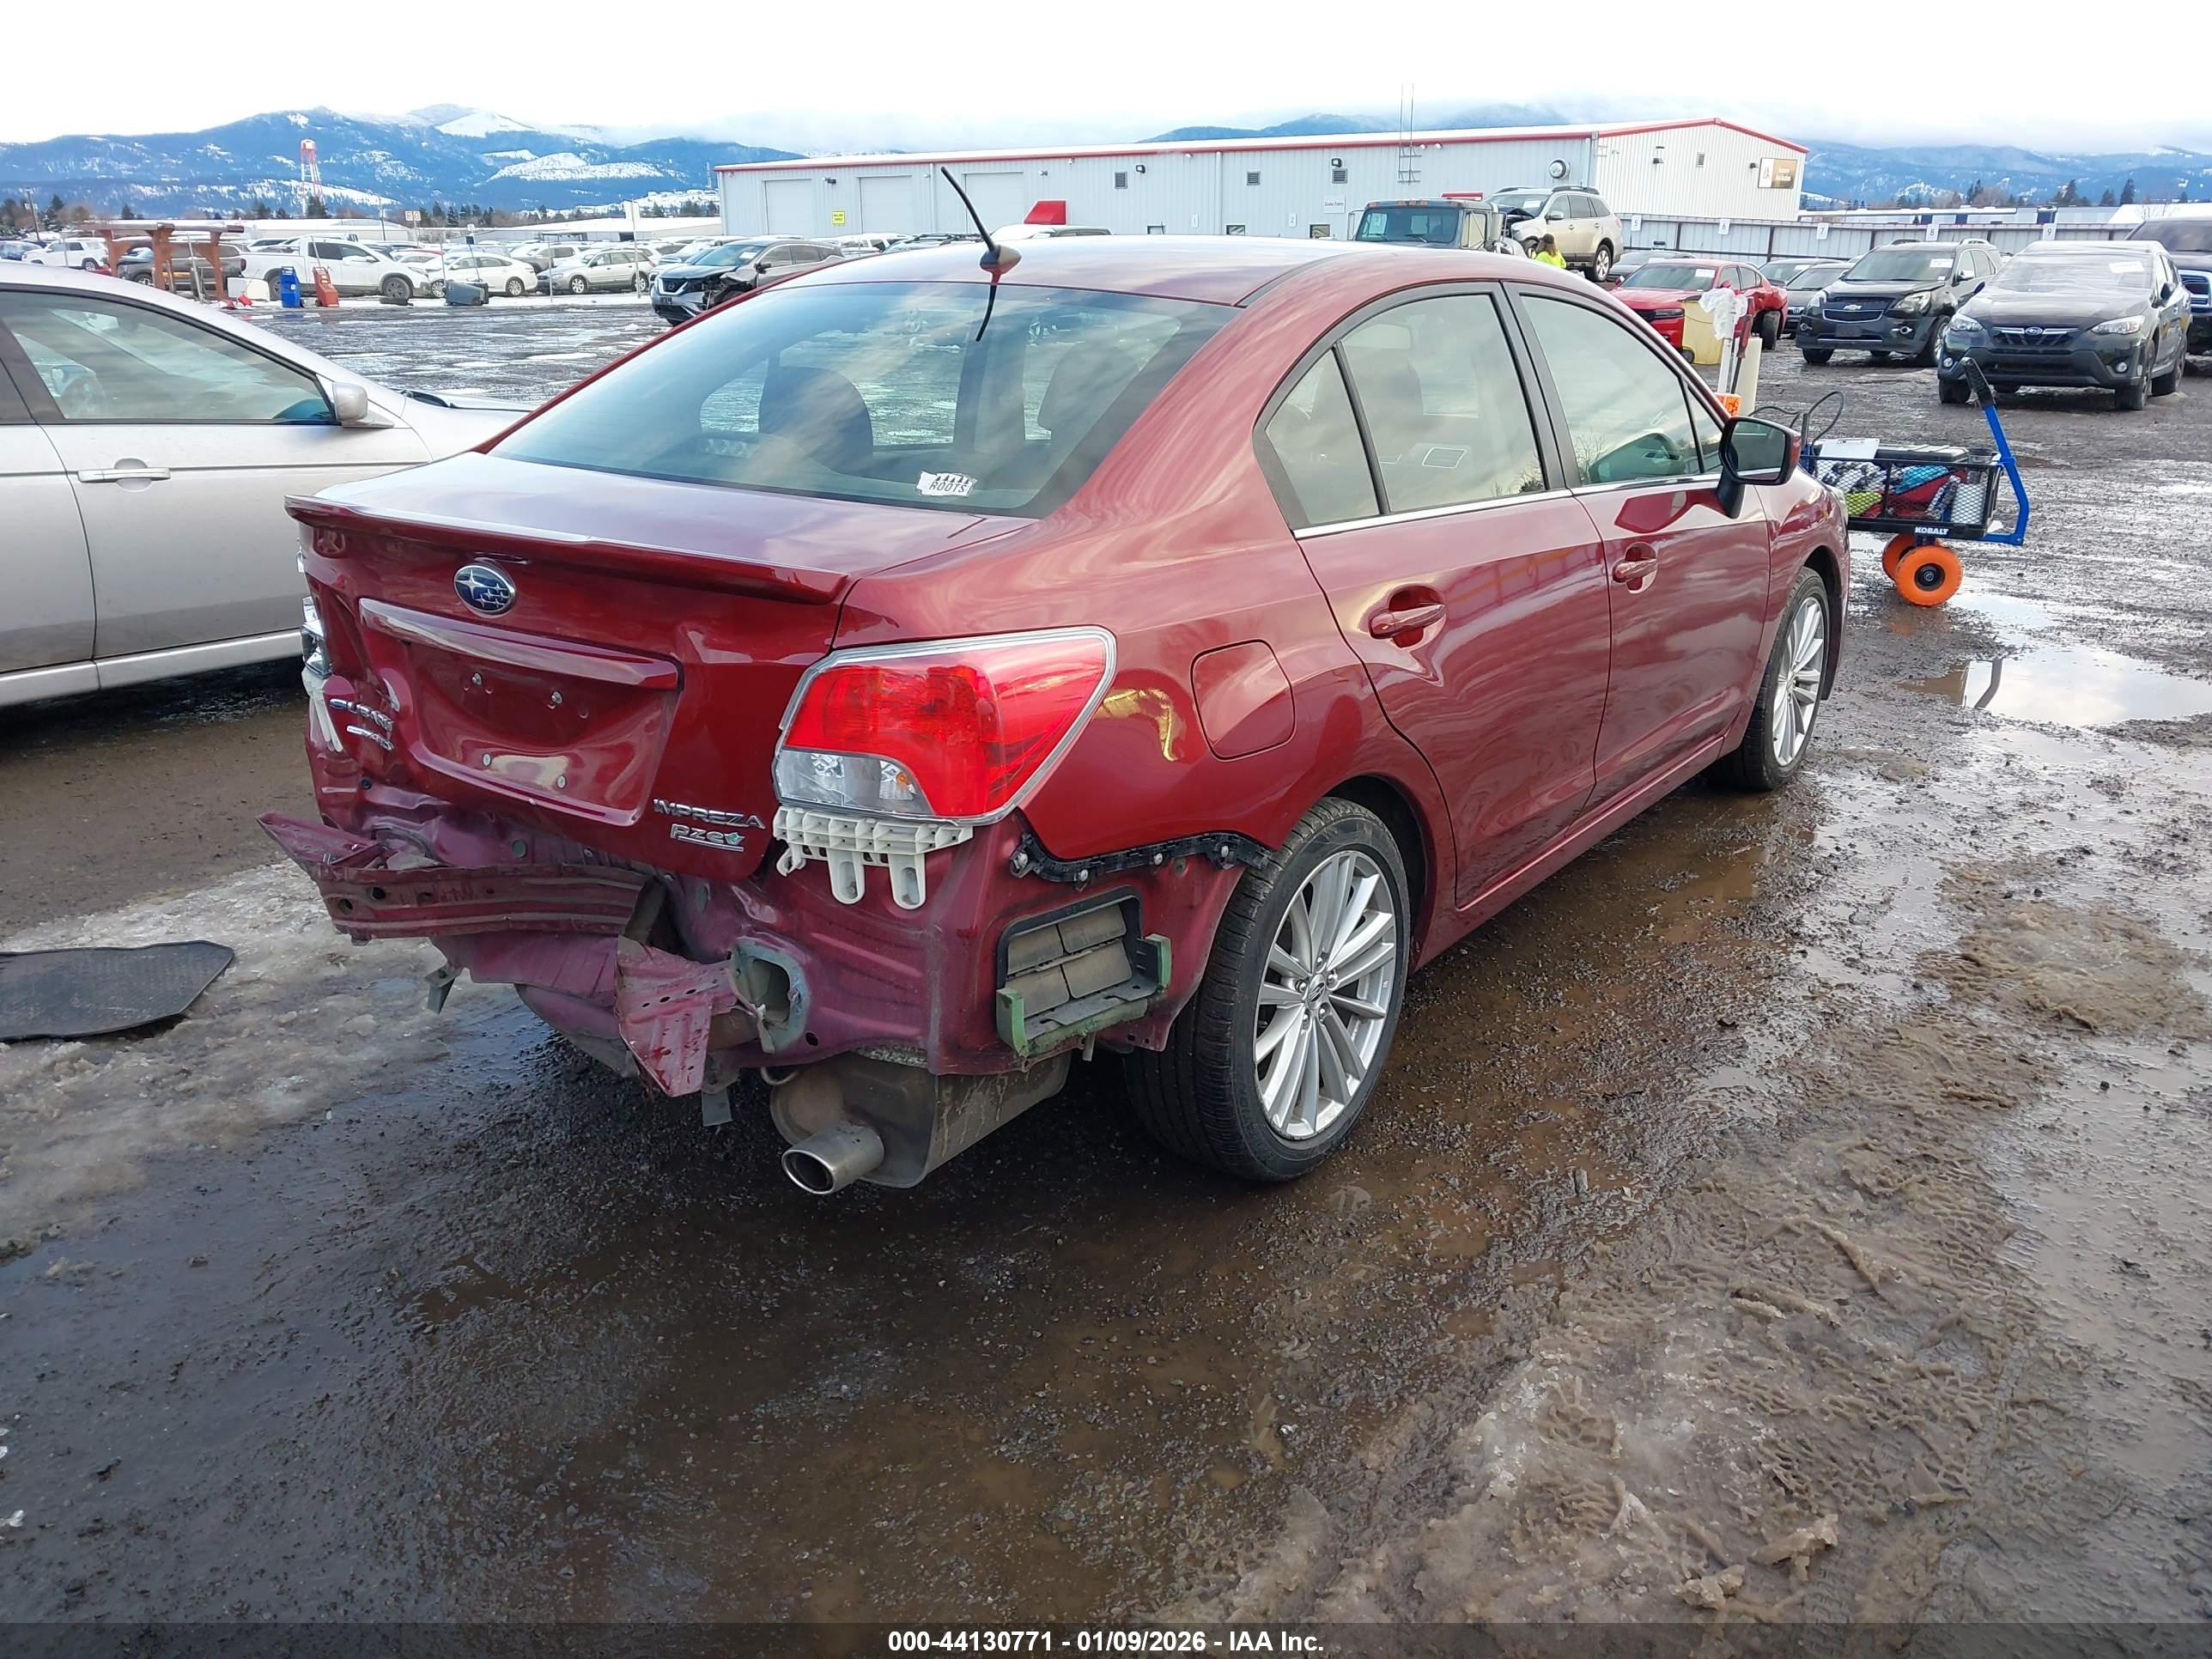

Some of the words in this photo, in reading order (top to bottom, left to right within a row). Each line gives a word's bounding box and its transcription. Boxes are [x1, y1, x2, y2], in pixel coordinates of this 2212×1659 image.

[928, 481, 968, 493] ROOTS
[1914, 526, 1949, 536] KOBALT
[653, 798, 766, 830] IMPREZA
